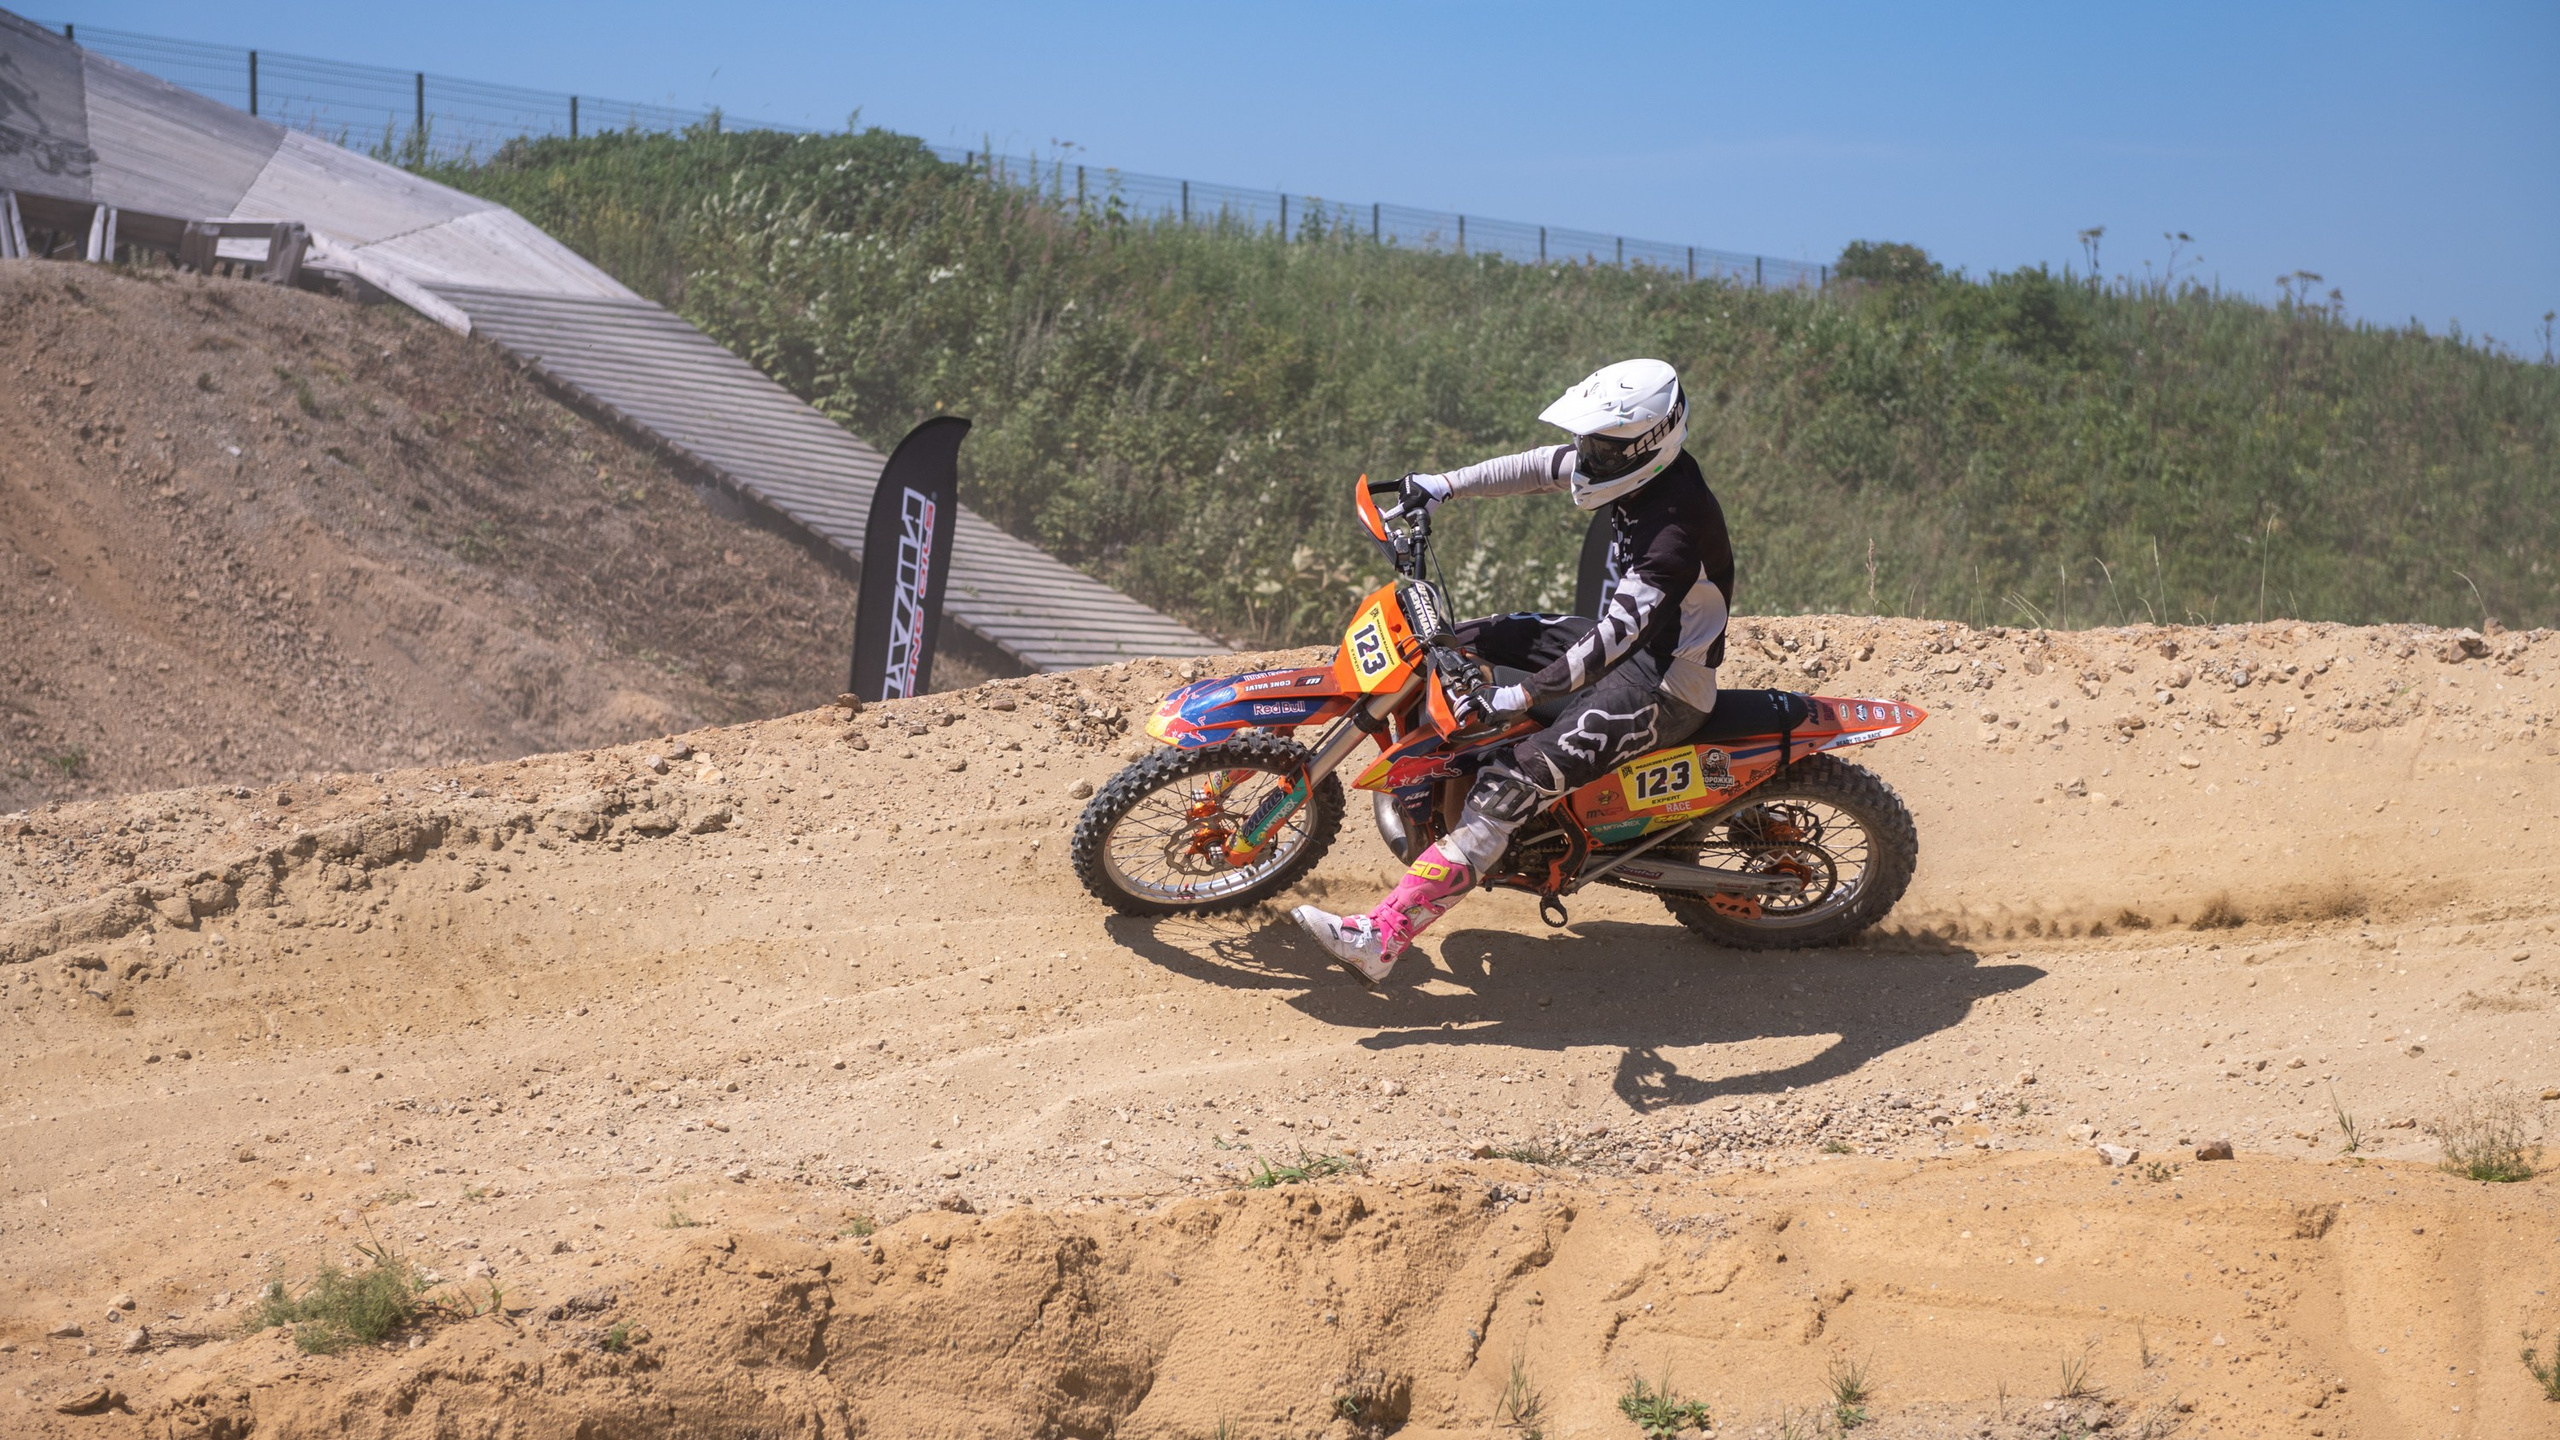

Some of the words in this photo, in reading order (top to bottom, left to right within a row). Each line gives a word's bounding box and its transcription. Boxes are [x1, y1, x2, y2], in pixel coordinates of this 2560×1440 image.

[918, 499, 936, 599] OILS
[1407, 586, 1432, 636] RENTHAL
[1353, 624, 1387, 675] 123
[1244, 682, 1269, 691] VALVE
[1269, 680, 1291, 688] CONE
[1253, 702, 1280, 716] Red
[1282, 701, 1306, 715] Bull
[1477, 695, 1494, 715] THOR
[1836, 738, 1853, 747] READY
[1867, 731, 1882, 740] RACE
[1635, 760, 1691, 801] 123
[1703, 776, 1733, 784] ОРОЖКИ
[1651, 794, 1682, 805] EXPERT
[1665, 801, 1692, 812] RACE
[1264, 799, 1298, 831] MOTOREX
